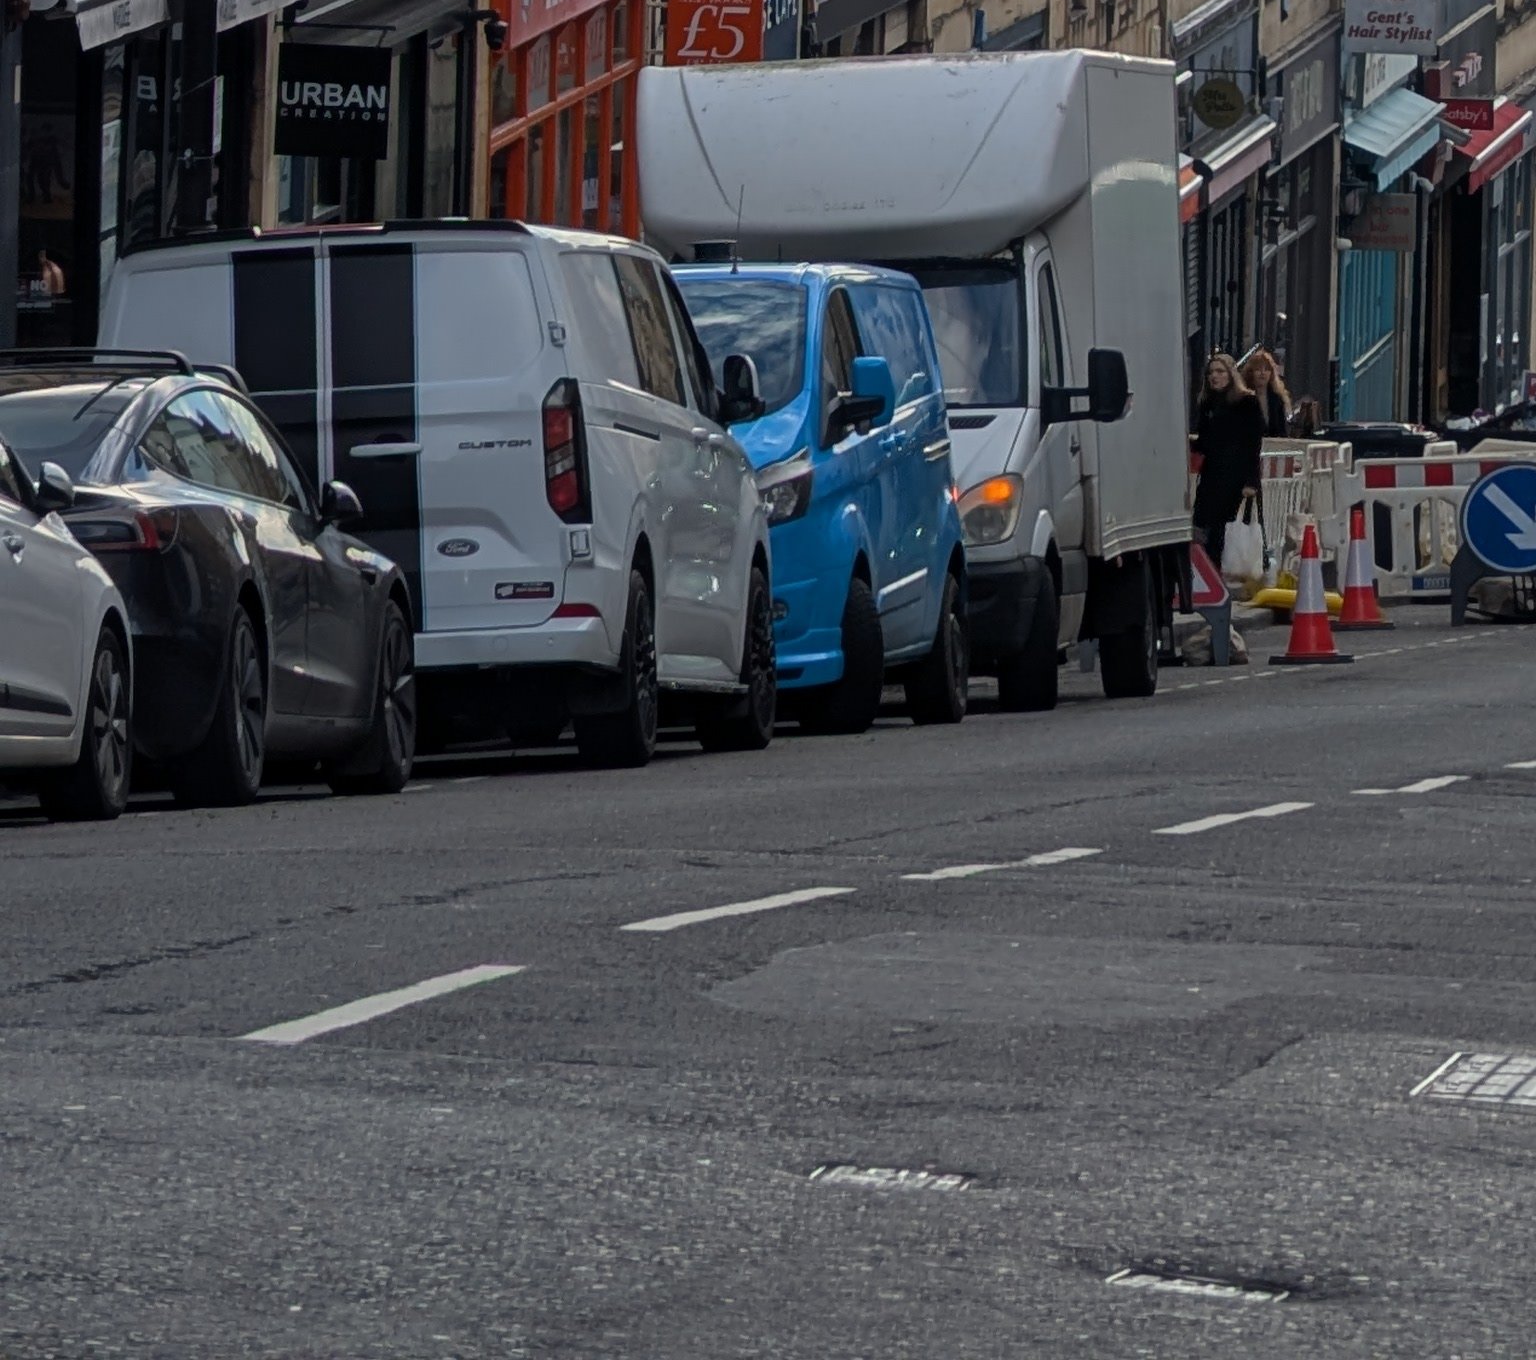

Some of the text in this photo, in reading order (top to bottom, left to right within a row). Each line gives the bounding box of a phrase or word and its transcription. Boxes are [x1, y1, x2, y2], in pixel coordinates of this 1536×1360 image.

[1366, 11, 1414, 25] Gent's
[677, 4, 750, 59] £5
[1348, 25, 1432, 43] Hair Stylist
[280, 80, 386, 109] URBAN
[280, 107, 386, 121] CREATION
[458, 439, 532, 450] CUSTOM
[444, 541, 471, 554] Ford
